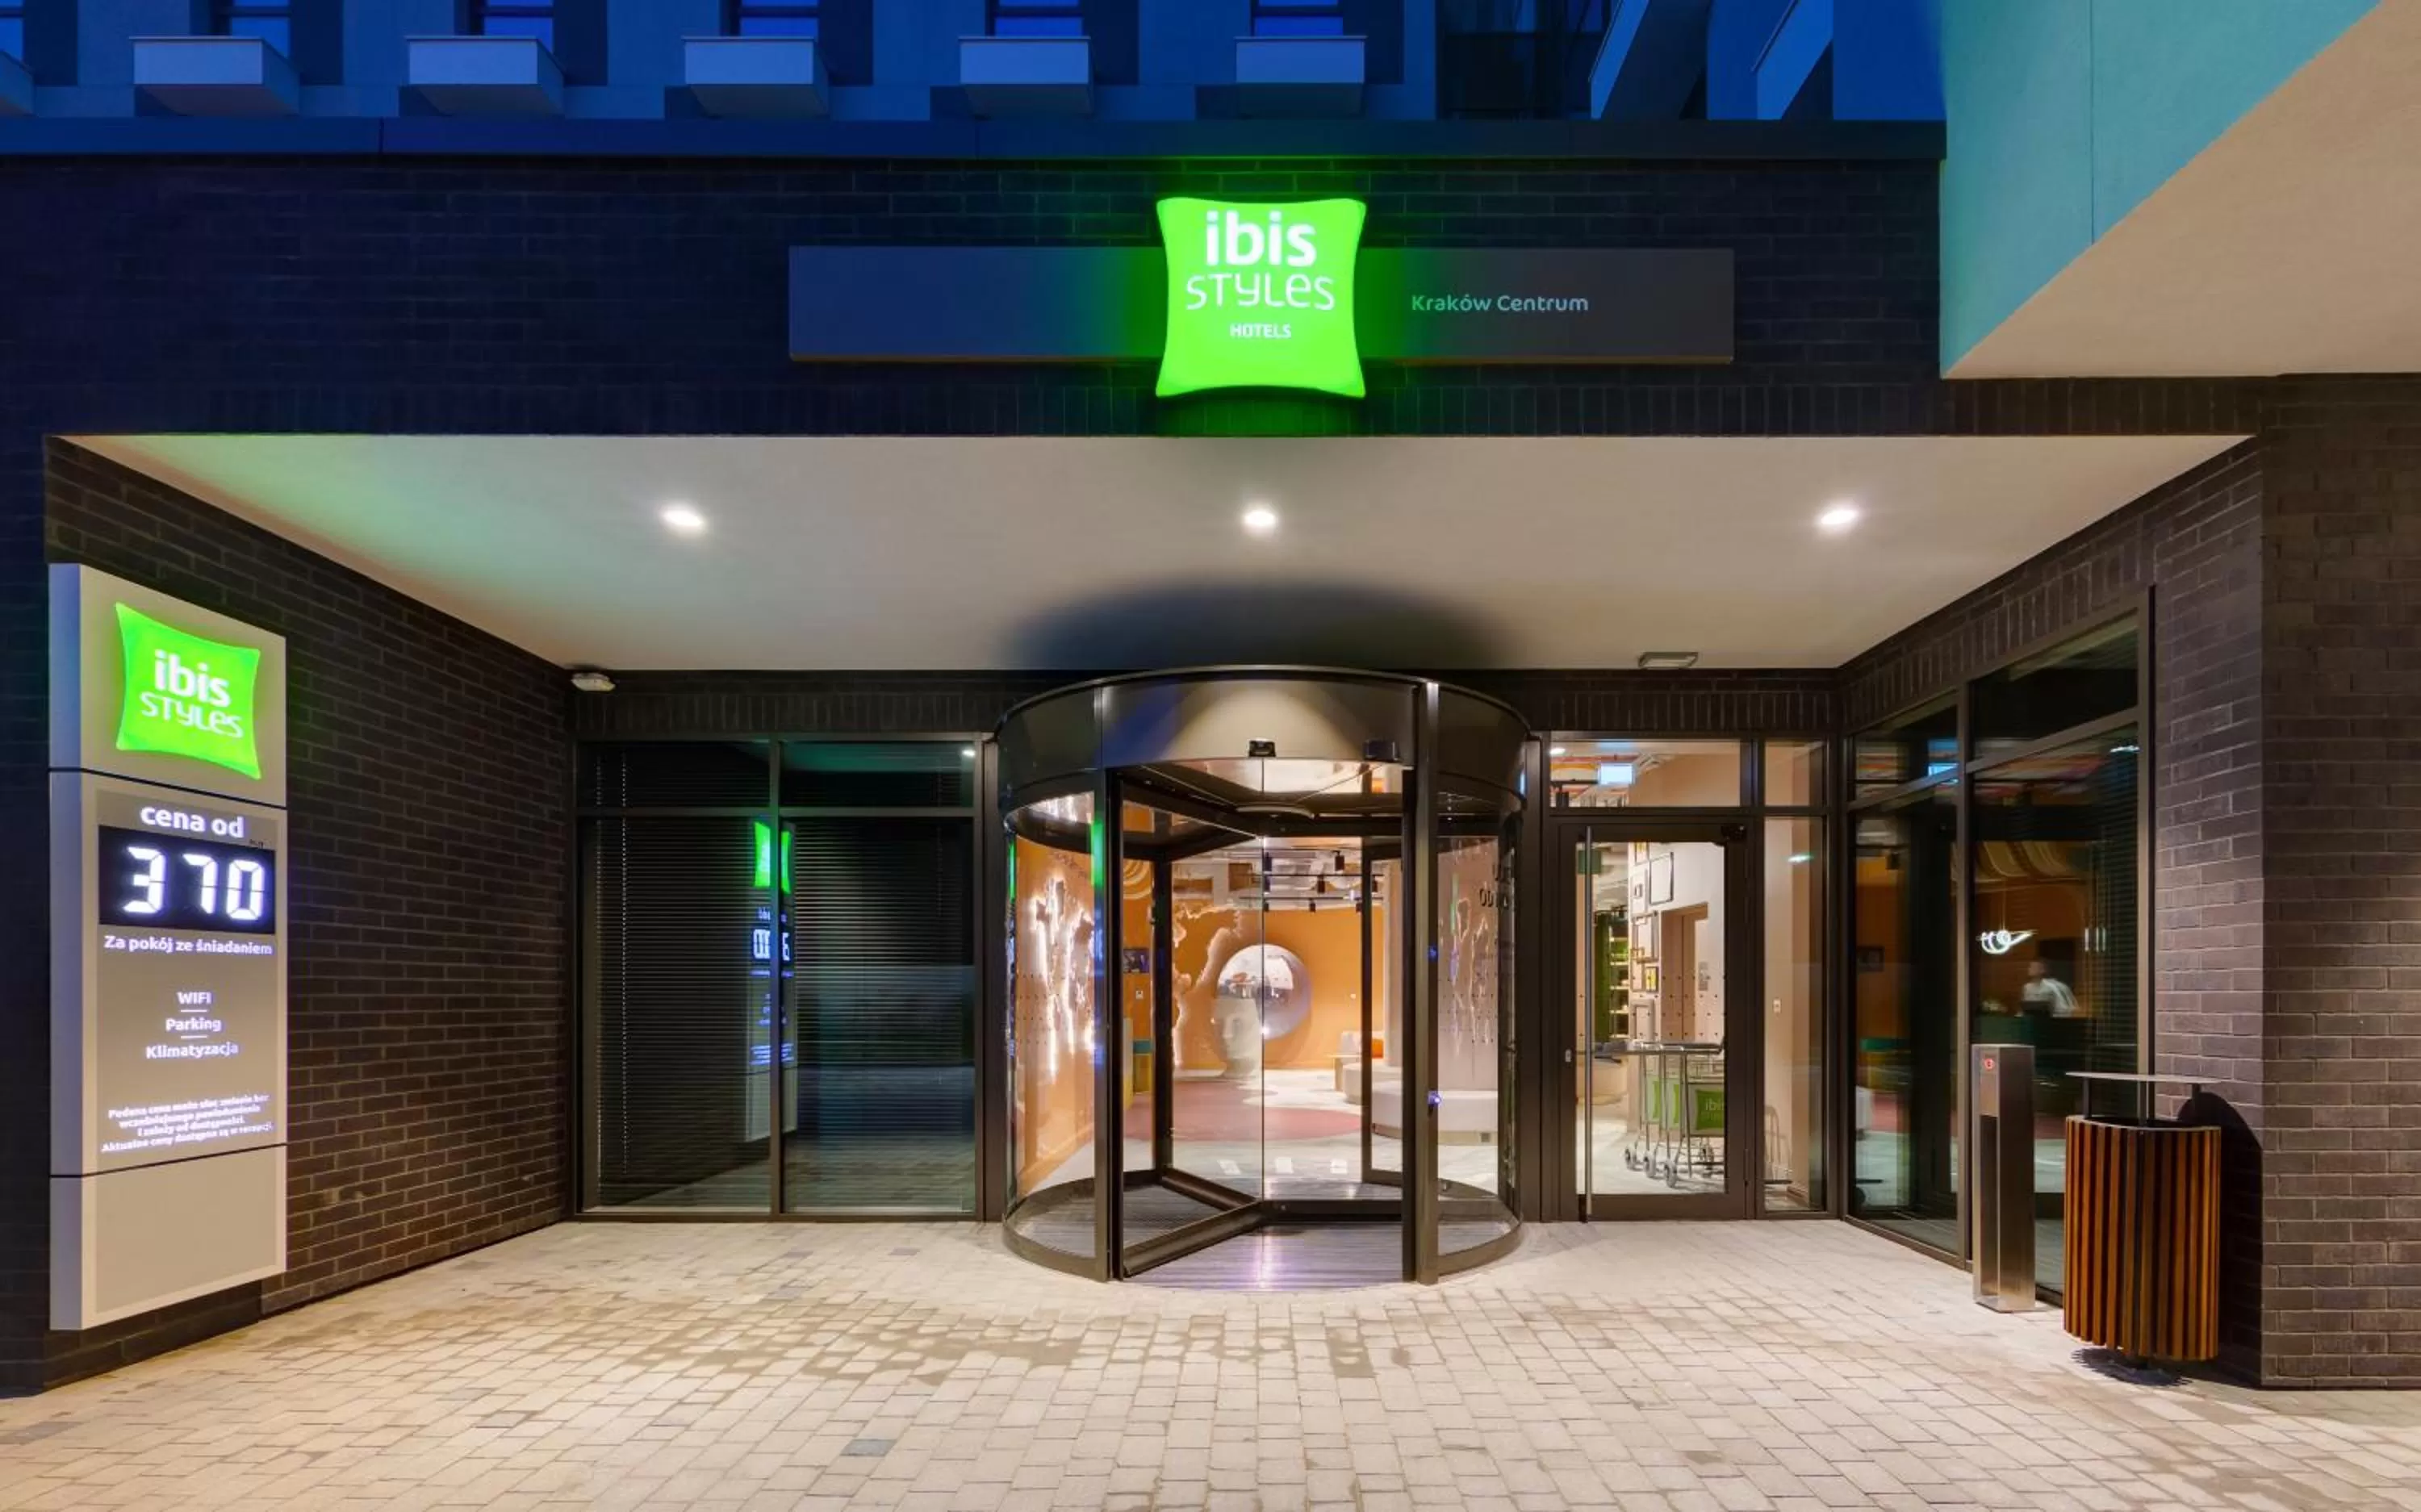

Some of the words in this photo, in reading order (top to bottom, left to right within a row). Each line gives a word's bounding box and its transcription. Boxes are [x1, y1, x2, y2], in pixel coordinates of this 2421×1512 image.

[1206, 210, 1317, 267] ibis
[1411, 294, 1492, 311] Kraków
[1497, 294, 1589, 311] Centrum
[1229, 323, 1291, 339] HOTELS
[154, 649, 232, 708] ibis
[140, 807, 206, 832] cena
[211, 816, 244, 838] od
[123, 846, 265, 921] 370
[103, 935, 126, 949] Za
[128, 936, 174, 954] pokój
[175, 940, 194, 952] ze
[195, 938, 273, 955] śniadaniem
[177, 991, 212, 1005] WIFI
[165, 1017, 223, 1033] Parking
[145, 1041, 239, 1059] Klimatyzacja
